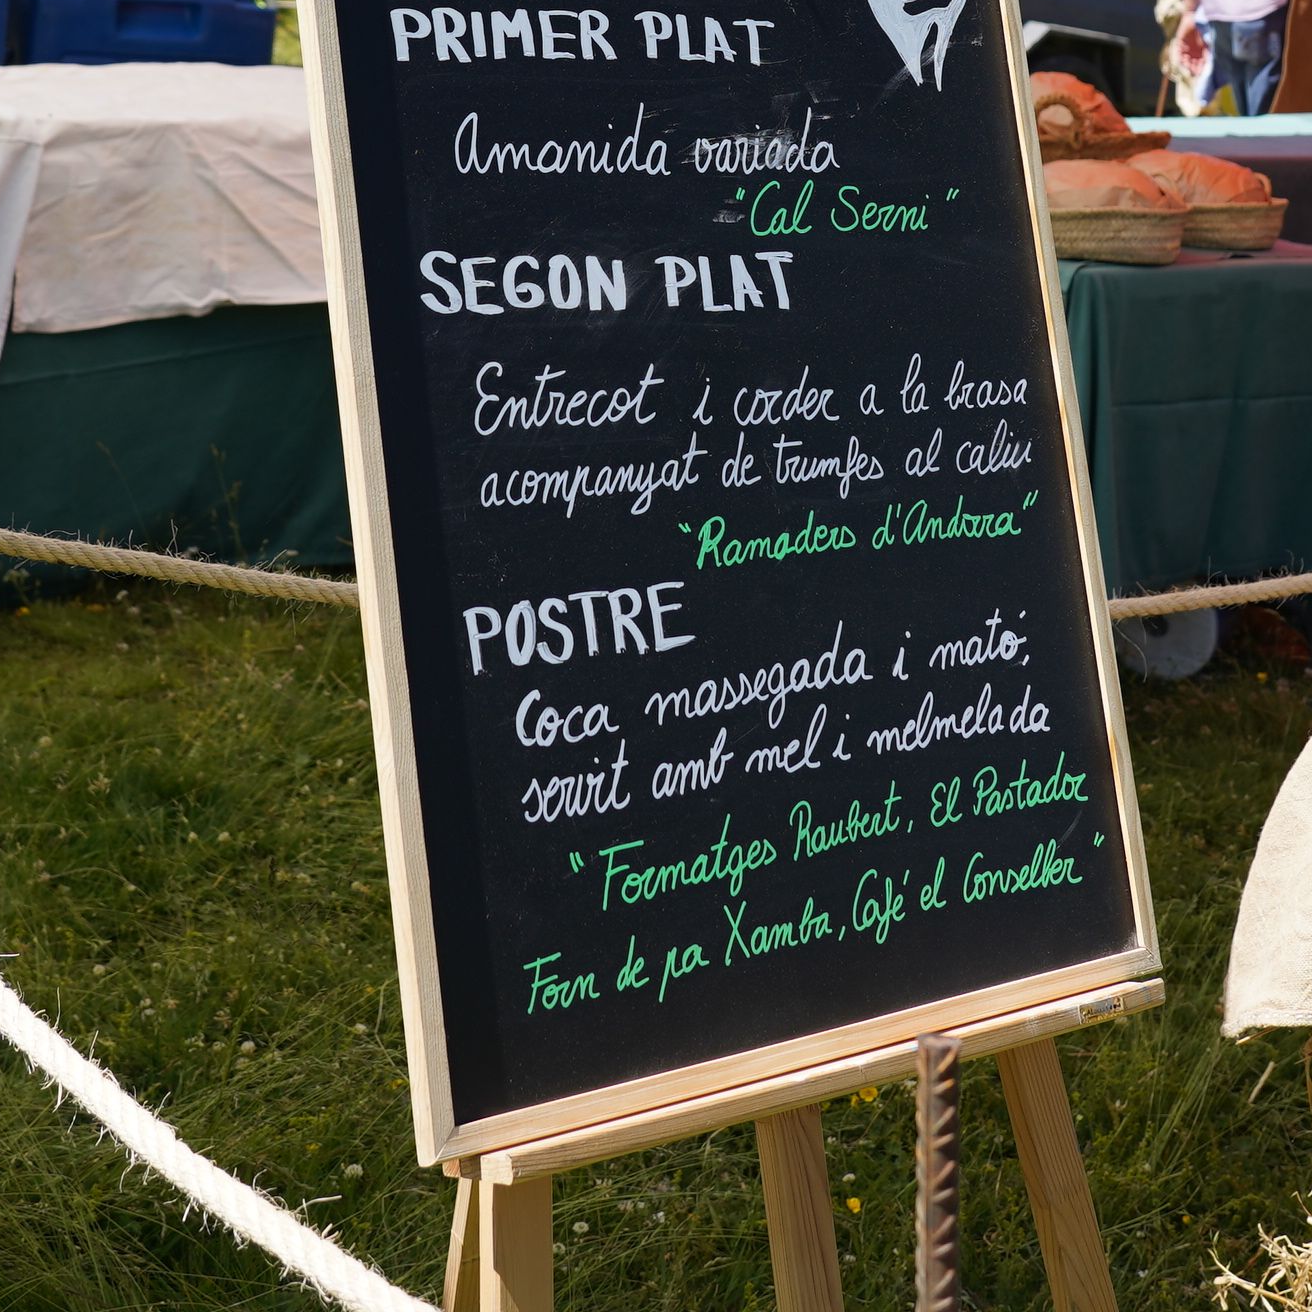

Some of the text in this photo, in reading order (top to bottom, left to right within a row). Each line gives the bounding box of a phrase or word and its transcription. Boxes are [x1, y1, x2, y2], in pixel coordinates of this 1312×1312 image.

[389, 7, 775, 67] PRIMER PLAT
[454, 101, 841, 176] Amanida variada
[419, 250, 794, 316] SEGON PLAT
[474, 352, 1028, 436] Entrecot i corder a la brasa
[480, 418, 1032, 519] acompanyat de trumfes al caliu
[462, 581, 697, 676] POSTRE
[515, 688, 620, 747] Coca
[644, 619, 874, 730] massegada
[891, 630, 912, 681] i
[521, 738, 631, 823] servit
[651, 726, 735, 800] amb
[744, 703, 828, 774] mel
[831, 713, 852, 761] i
[930, 776, 963, 828] El
[523, 951, 601, 1015] Forn
[616, 934, 650, 992] de
[658, 943, 710, 1003] pa
[919, 856, 947, 911] el
